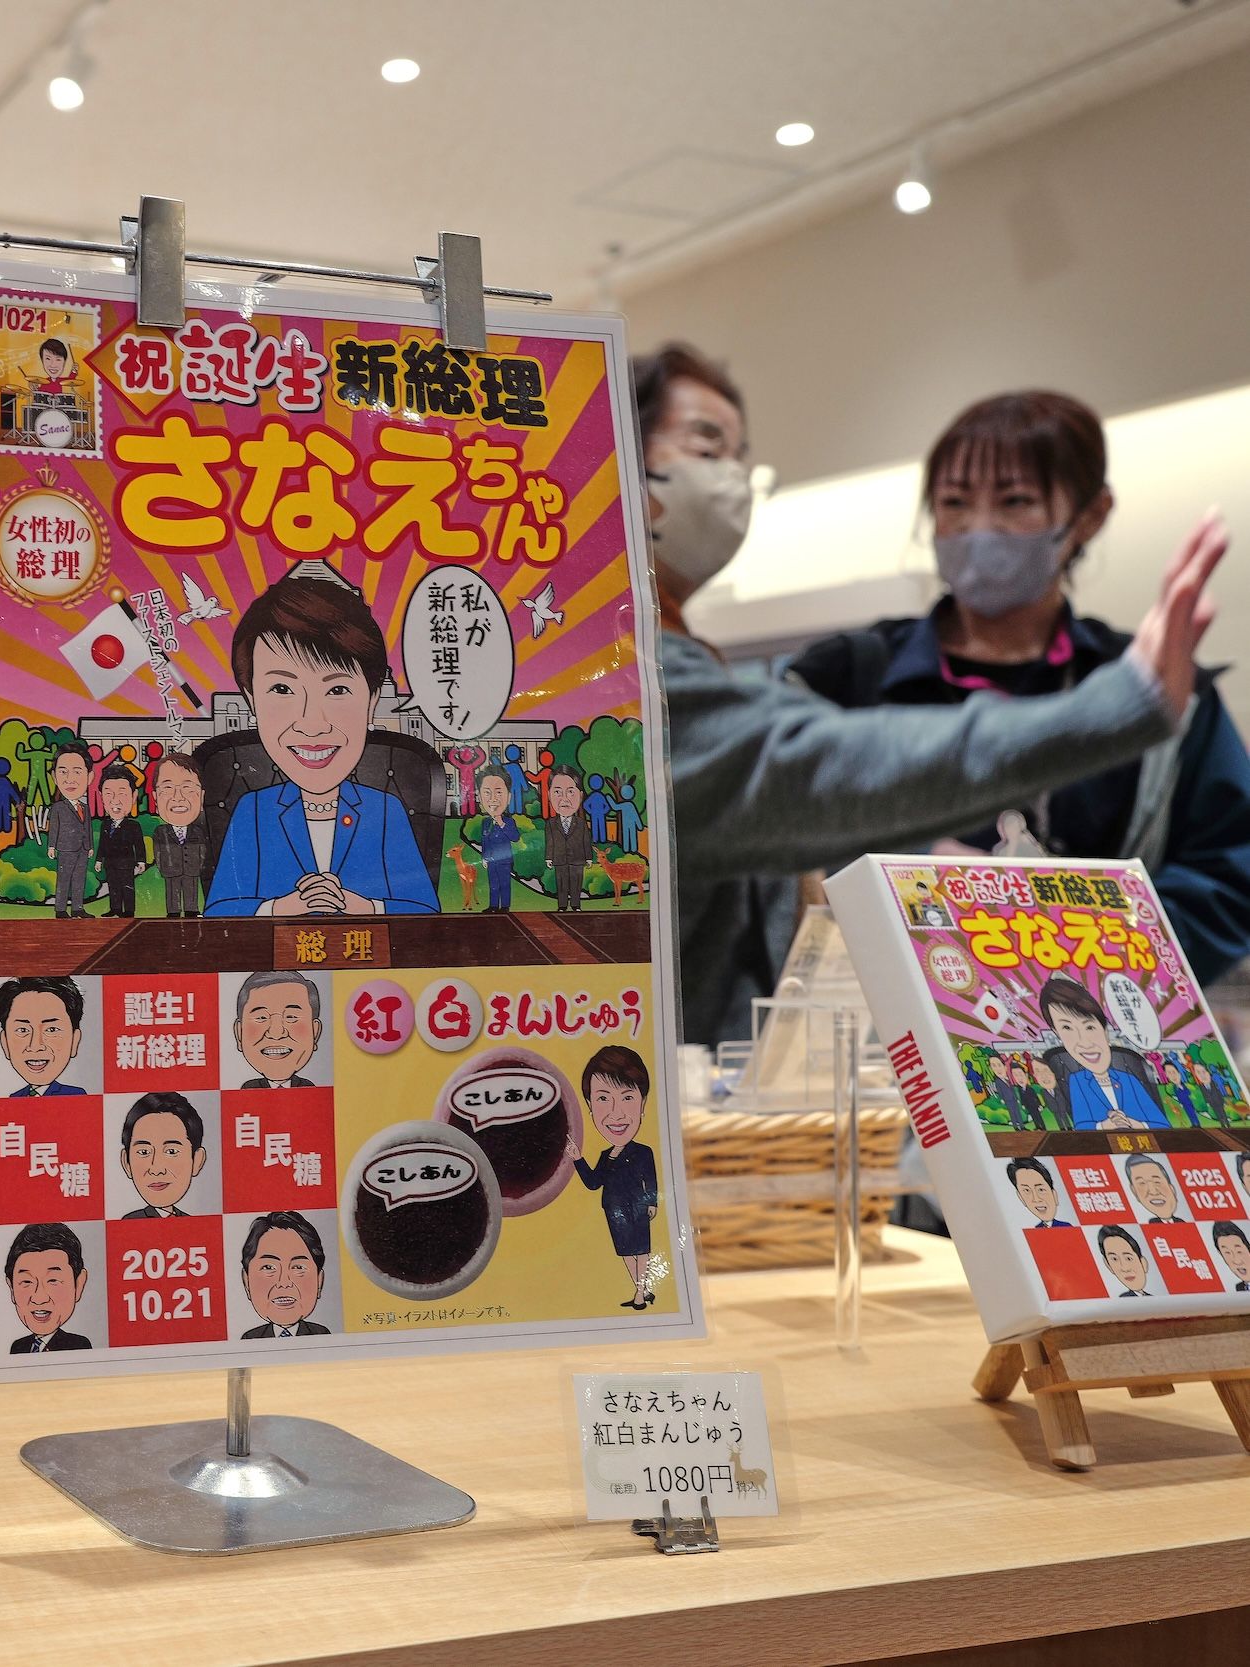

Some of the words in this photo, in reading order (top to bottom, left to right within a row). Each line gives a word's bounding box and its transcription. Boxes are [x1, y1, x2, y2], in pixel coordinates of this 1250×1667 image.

[114, 415, 563, 562] さなえちゃん
[6, 515, 91, 544] 女性初の
[16, 548, 81, 580] 総理
[150, 590, 178, 651] 日本初の
[460, 583, 491, 647] 私が
[295, 929, 374, 963] 総理
[960, 909, 1156, 970] さなえちゃん
[123, 992, 195, 1026] 誕生!
[116, 1034, 206, 1070] 新総理
[887, 1031, 923, 1079] THE
[464, 1088, 544, 1107] こしあん
[900, 1072, 951, 1150] MANJU
[235, 1114, 322, 1187] 自民糖
[1116, 1135, 1153, 1151] 総理
[0, 1123, 91, 1198] 自民糖
[377, 1165, 462, 1184] こしあん
[1182, 1169, 1226, 1187] 2025
[1075, 1193, 1126, 1213] 新総理
[1190, 1191, 1237, 1209] 10.21
[122, 1247, 209, 1280] 2025
[122, 1288, 213, 1322] 10.21
[604, 1391, 732, 1413] さなえちゃん
[593, 1422, 743, 1447] 紅白まんじゅう
